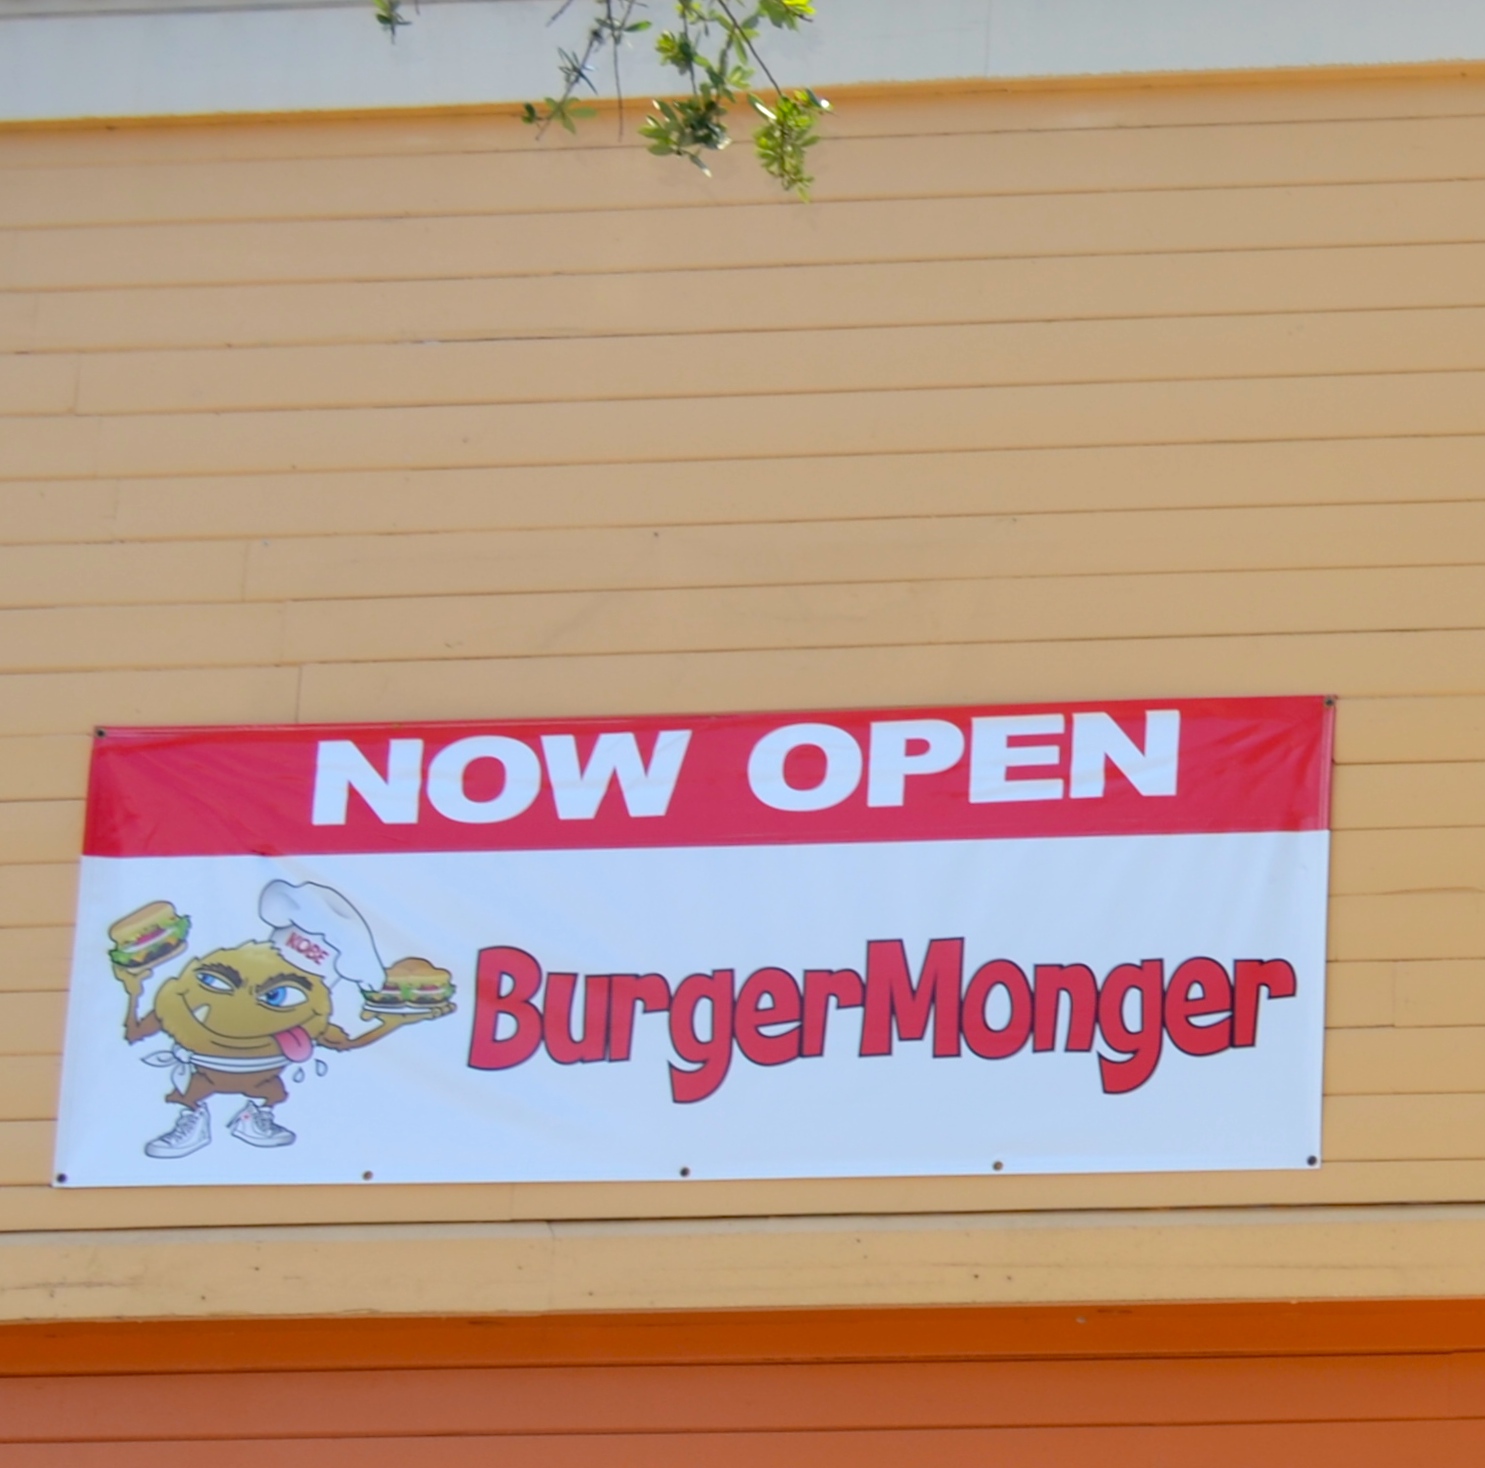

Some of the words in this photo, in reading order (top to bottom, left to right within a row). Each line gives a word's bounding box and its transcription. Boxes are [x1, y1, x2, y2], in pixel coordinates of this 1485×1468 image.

[311, 730, 692, 826] NOW
[747, 709, 1181, 813] OPEN
[286, 932, 329, 965] KOBE
[467, 937, 1297, 1105] BurgerMonger
